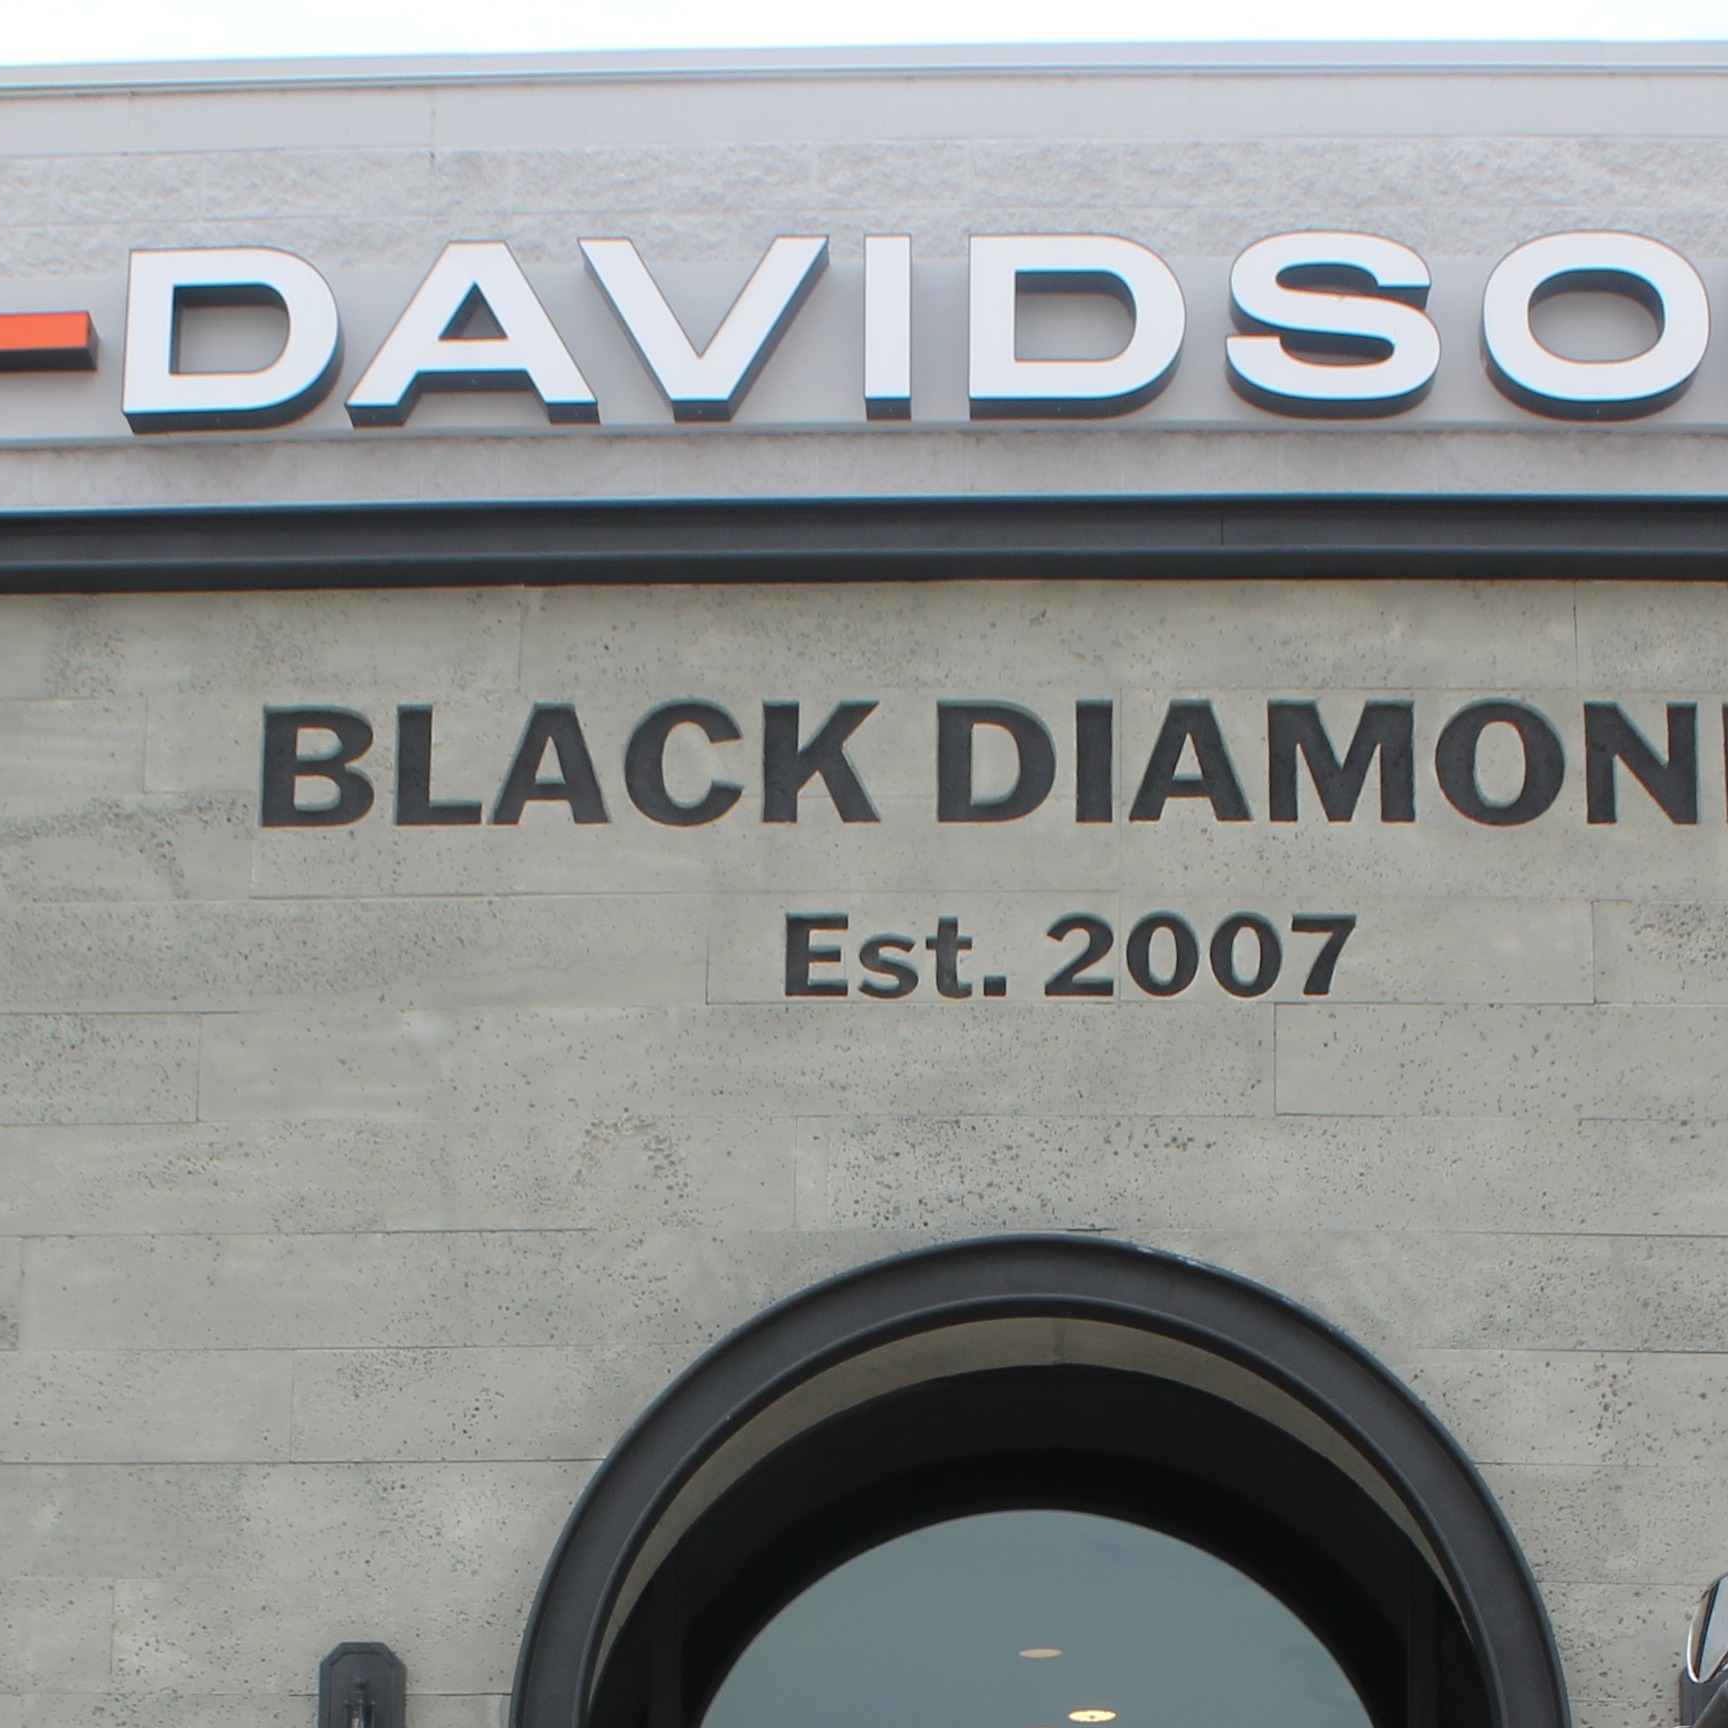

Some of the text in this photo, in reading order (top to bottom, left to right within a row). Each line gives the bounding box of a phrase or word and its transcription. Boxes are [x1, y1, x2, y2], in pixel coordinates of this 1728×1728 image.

[259, 699, 879, 828] BLACK
[783, 908, 1358, 998] Est. 2007
